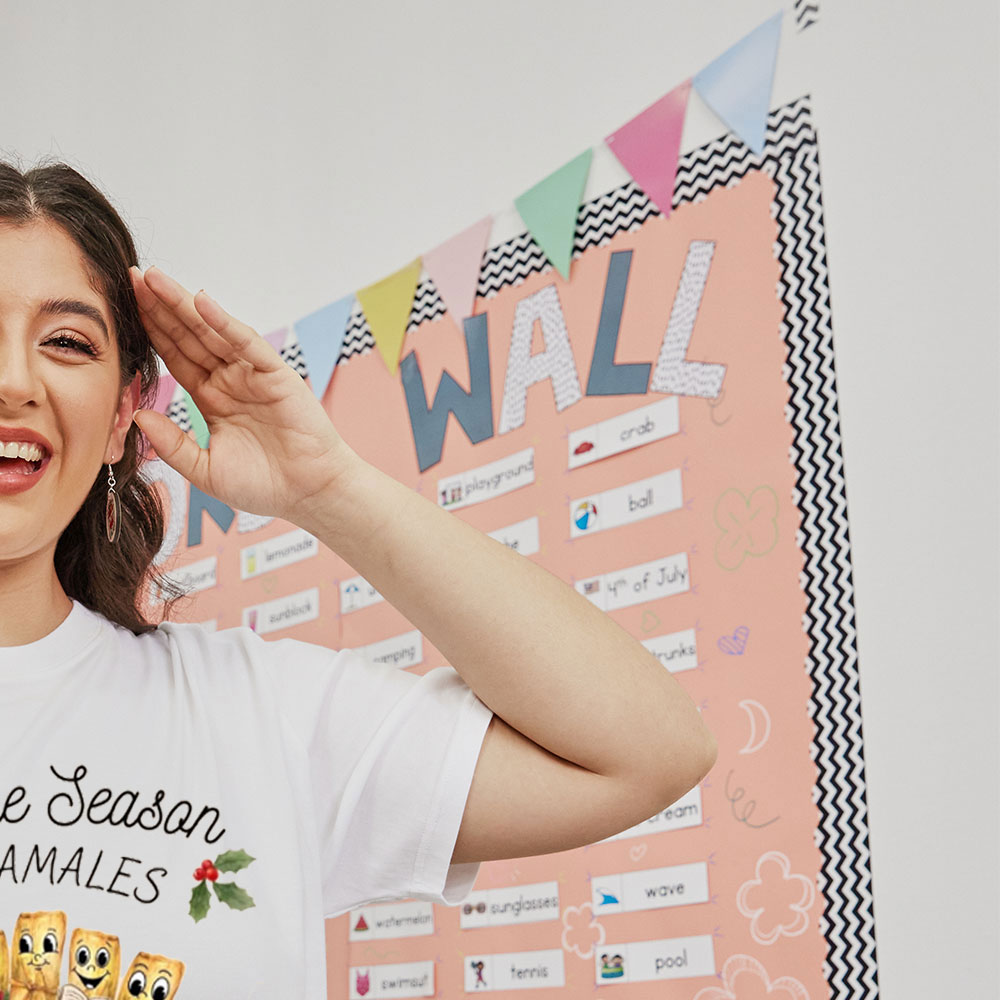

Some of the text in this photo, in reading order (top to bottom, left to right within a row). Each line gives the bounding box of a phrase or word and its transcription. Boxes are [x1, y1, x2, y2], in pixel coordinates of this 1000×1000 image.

[400, 240, 727, 472] WALL
[620, 416, 655, 442] crab
[465, 453, 534, 497] playground
[628, 488, 653, 511] ball
[266, 538, 314, 563] lemonade
[633, 571, 650, 592] of
[657, 566, 688, 587] July
[47, 765, 226, 844] Season
[645, 883, 686, 899] wave
[491, 893, 559, 918] sunglasses
[375, 912, 433, 930] watermelon
[511, 965, 549, 980] tennis
[655, 953, 689, 973] pool
